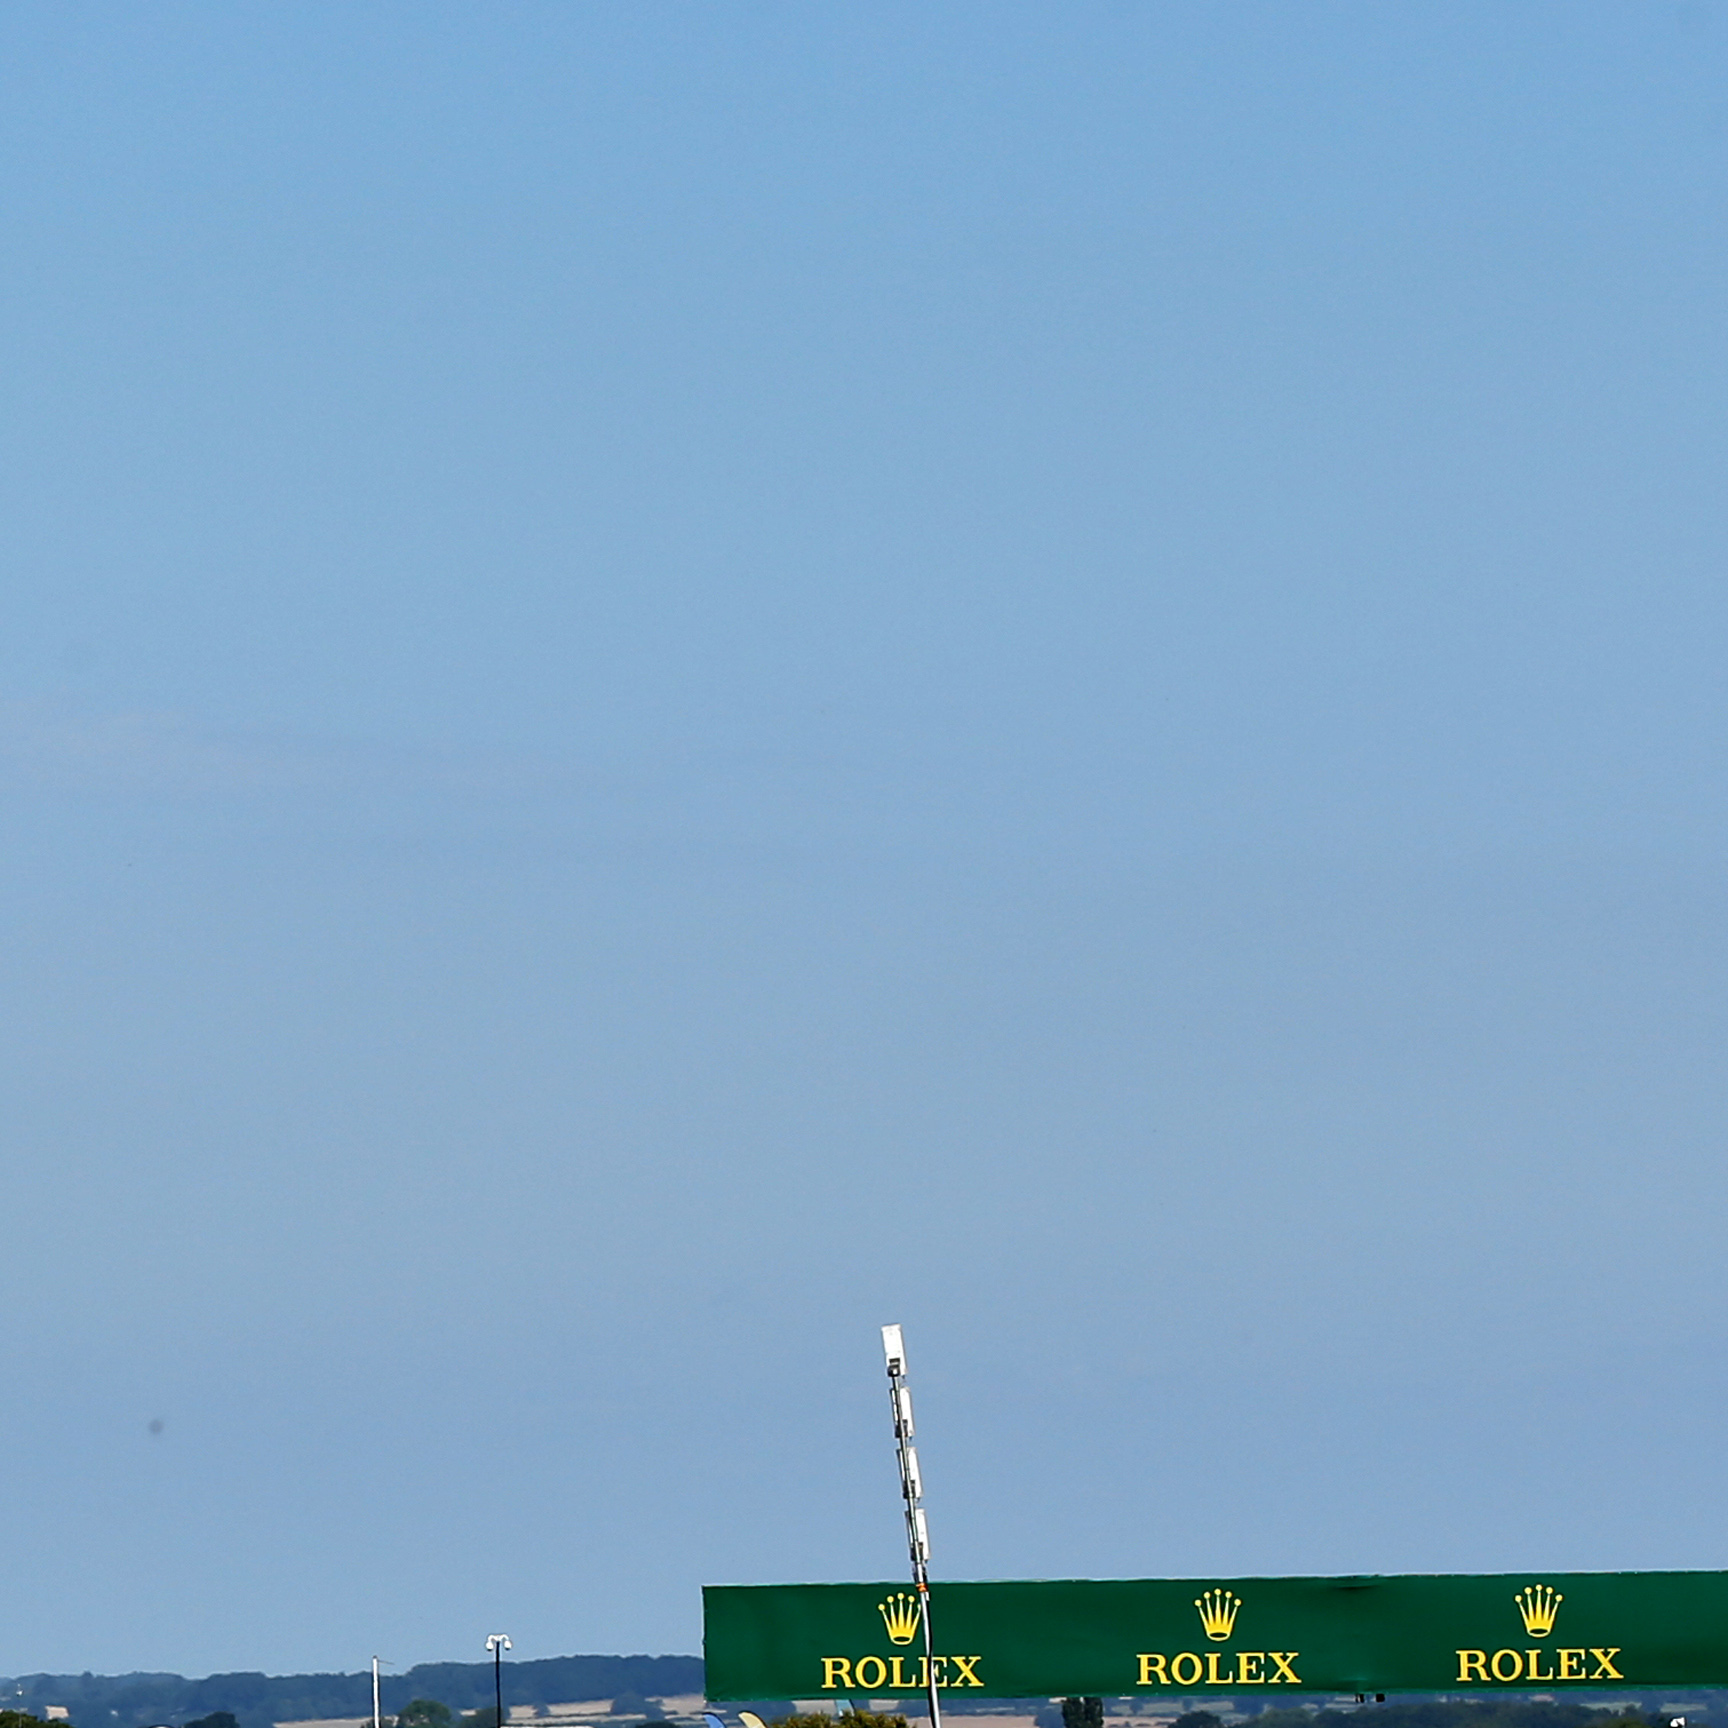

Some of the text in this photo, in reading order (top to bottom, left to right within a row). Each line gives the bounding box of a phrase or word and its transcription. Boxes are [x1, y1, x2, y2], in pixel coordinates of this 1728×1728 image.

[821, 1655, 984, 1689] ROLEX
[1136, 1652, 1302, 1685] ROLEX
[1456, 1647, 1624, 1682] ROLEX
